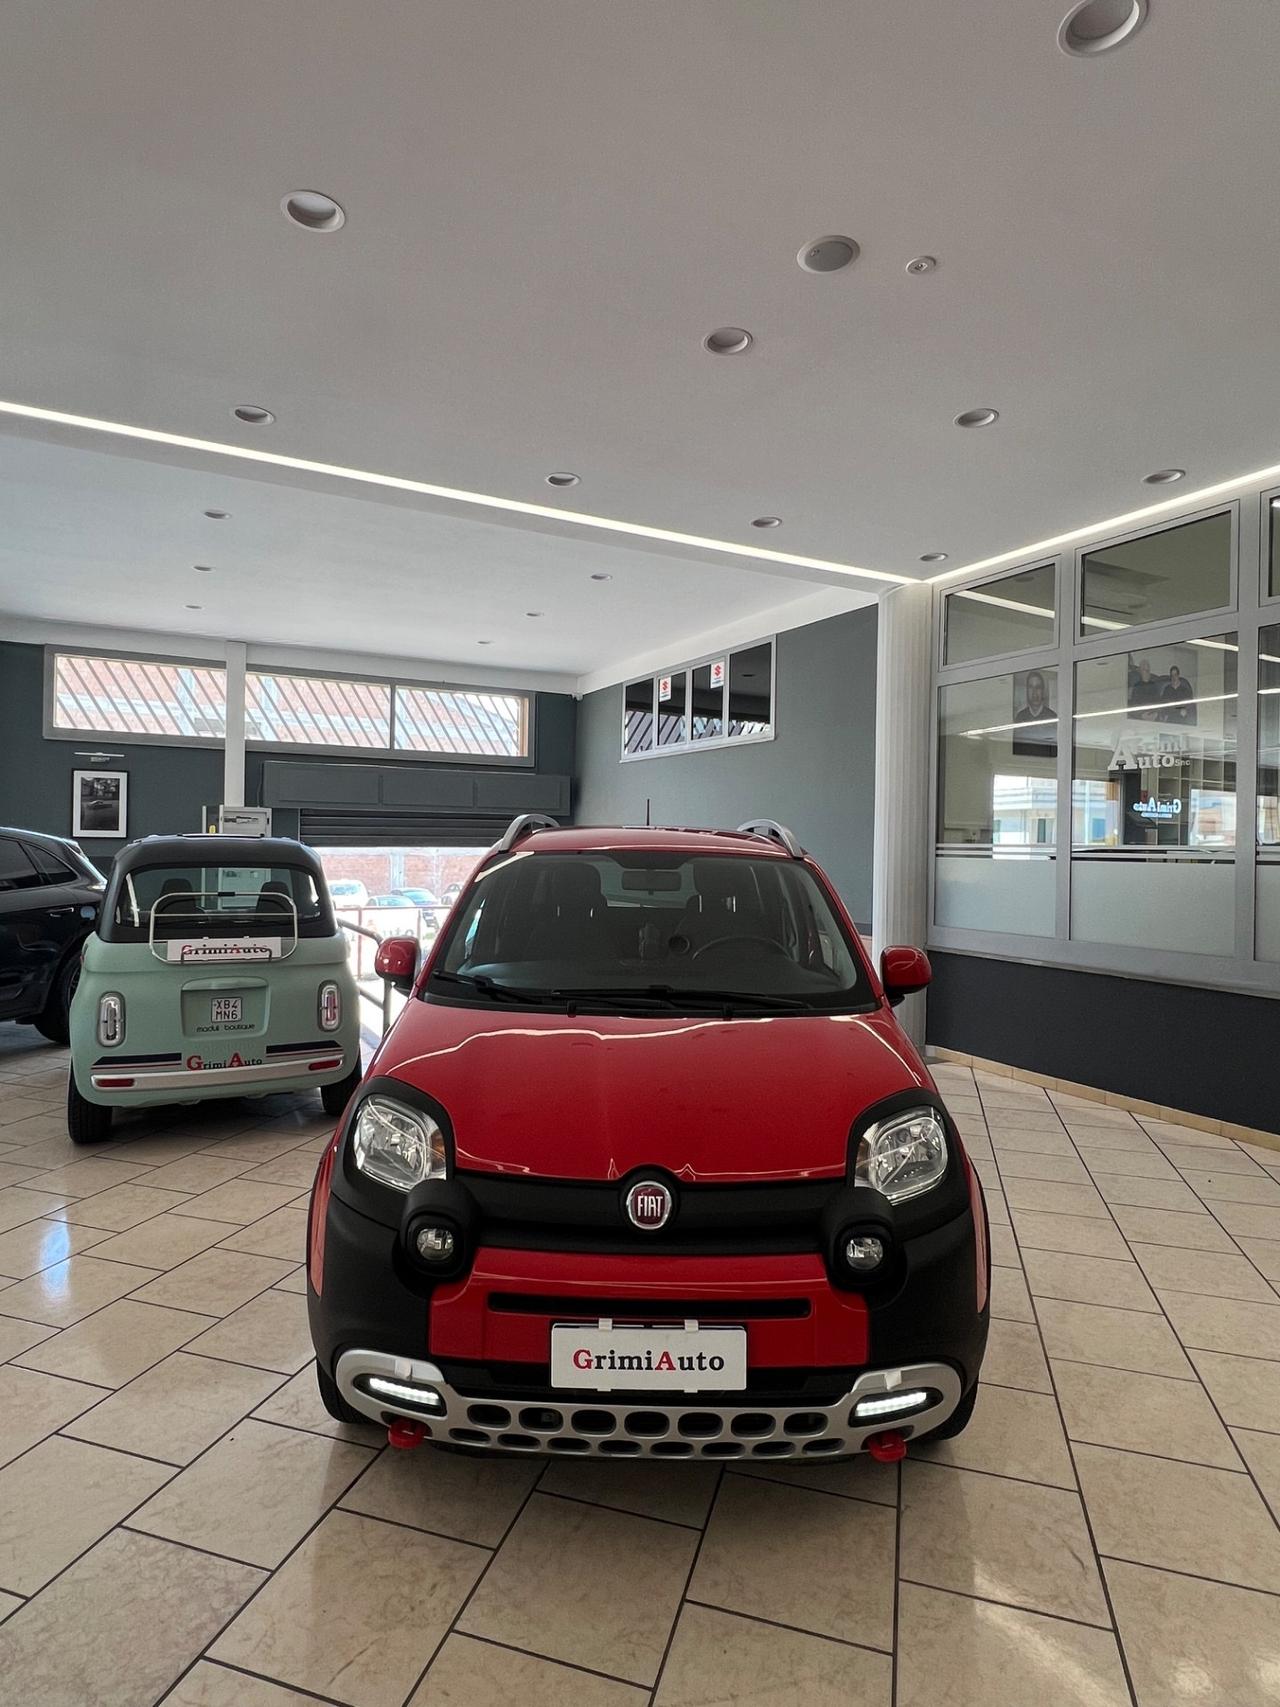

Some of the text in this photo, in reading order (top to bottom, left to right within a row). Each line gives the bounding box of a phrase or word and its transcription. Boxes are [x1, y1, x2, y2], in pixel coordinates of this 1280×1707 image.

[1107, 741, 1175, 770] Auto
[216, 1010, 238, 1020] MN6
[637, 1196, 663, 1217] FIAT
[573, 1350, 725, 1371] GrimiAuto
